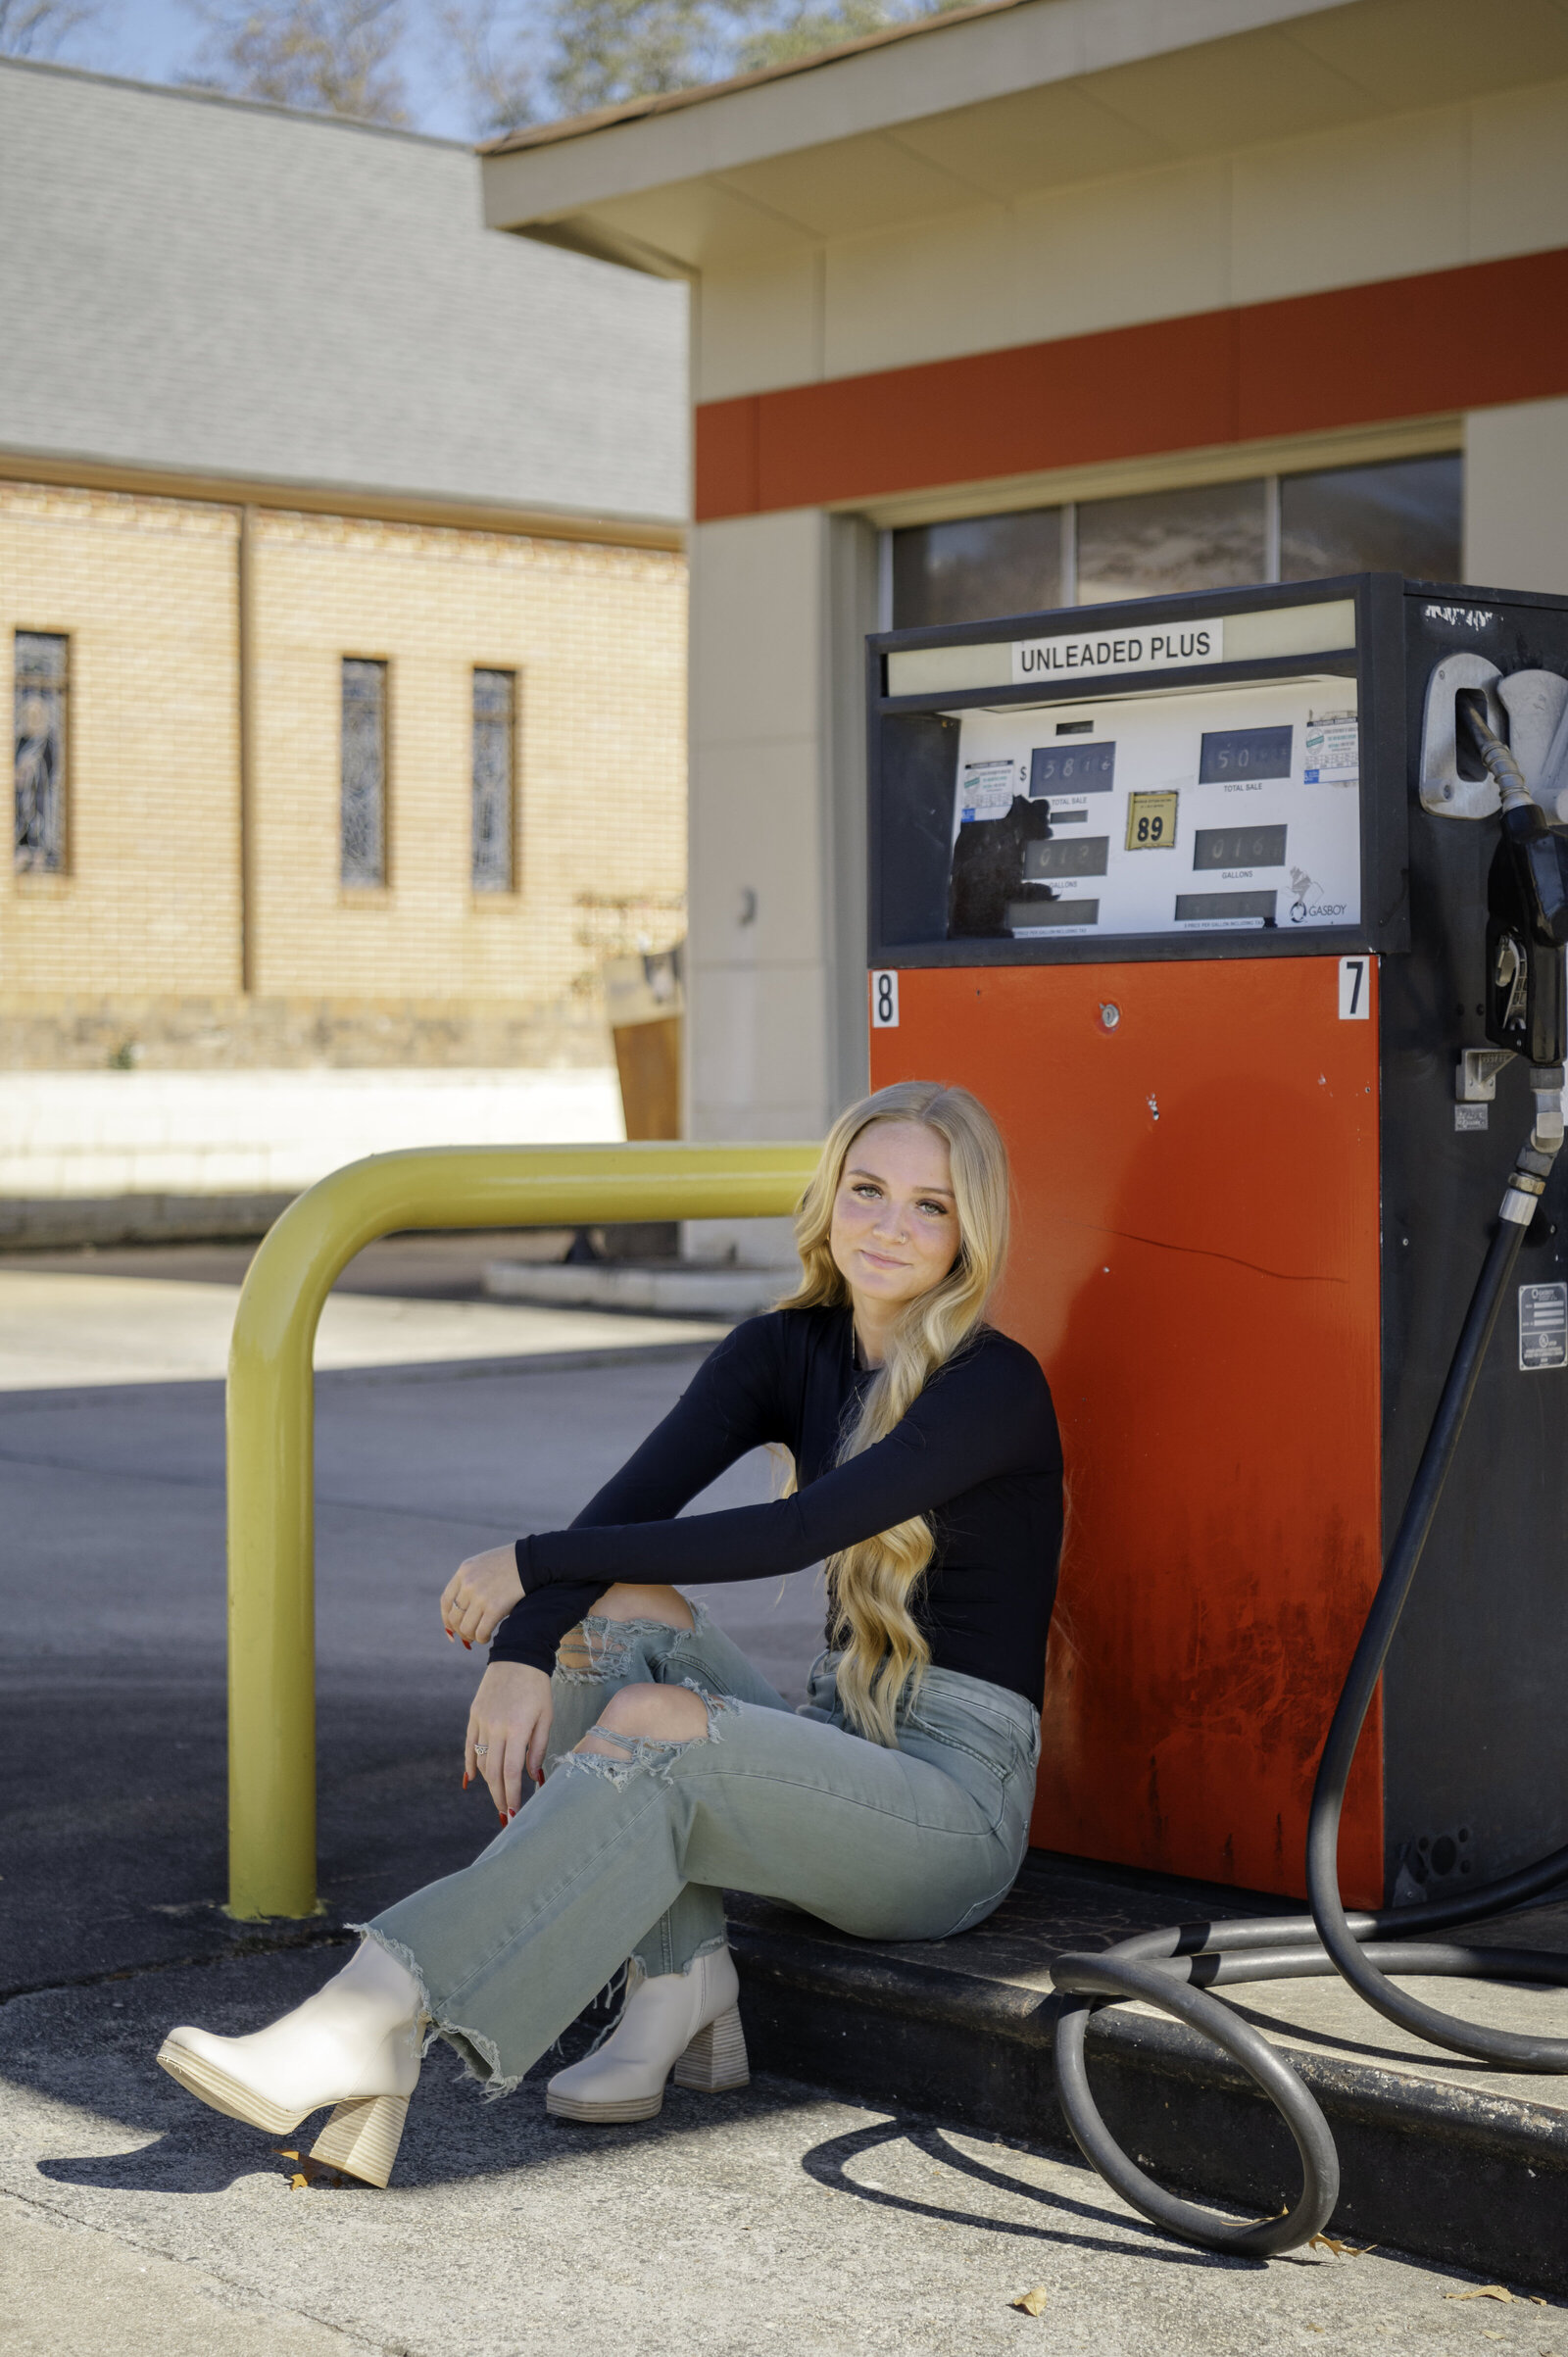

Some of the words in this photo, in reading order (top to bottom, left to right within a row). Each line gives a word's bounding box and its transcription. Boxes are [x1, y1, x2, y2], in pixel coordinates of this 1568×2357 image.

[1021, 639, 1143, 672] UNLEADED
[1151, 631, 1210, 660] PLUS
[1138, 816, 1163, 842] 89
[1050, 880, 1078, 889] GALLONS
[1222, 870, 1253, 879] GALLONS
[1308, 904, 1348, 917] GASBOY
[878, 974, 893, 1022] 8
[1347, 961, 1363, 1014] 7
